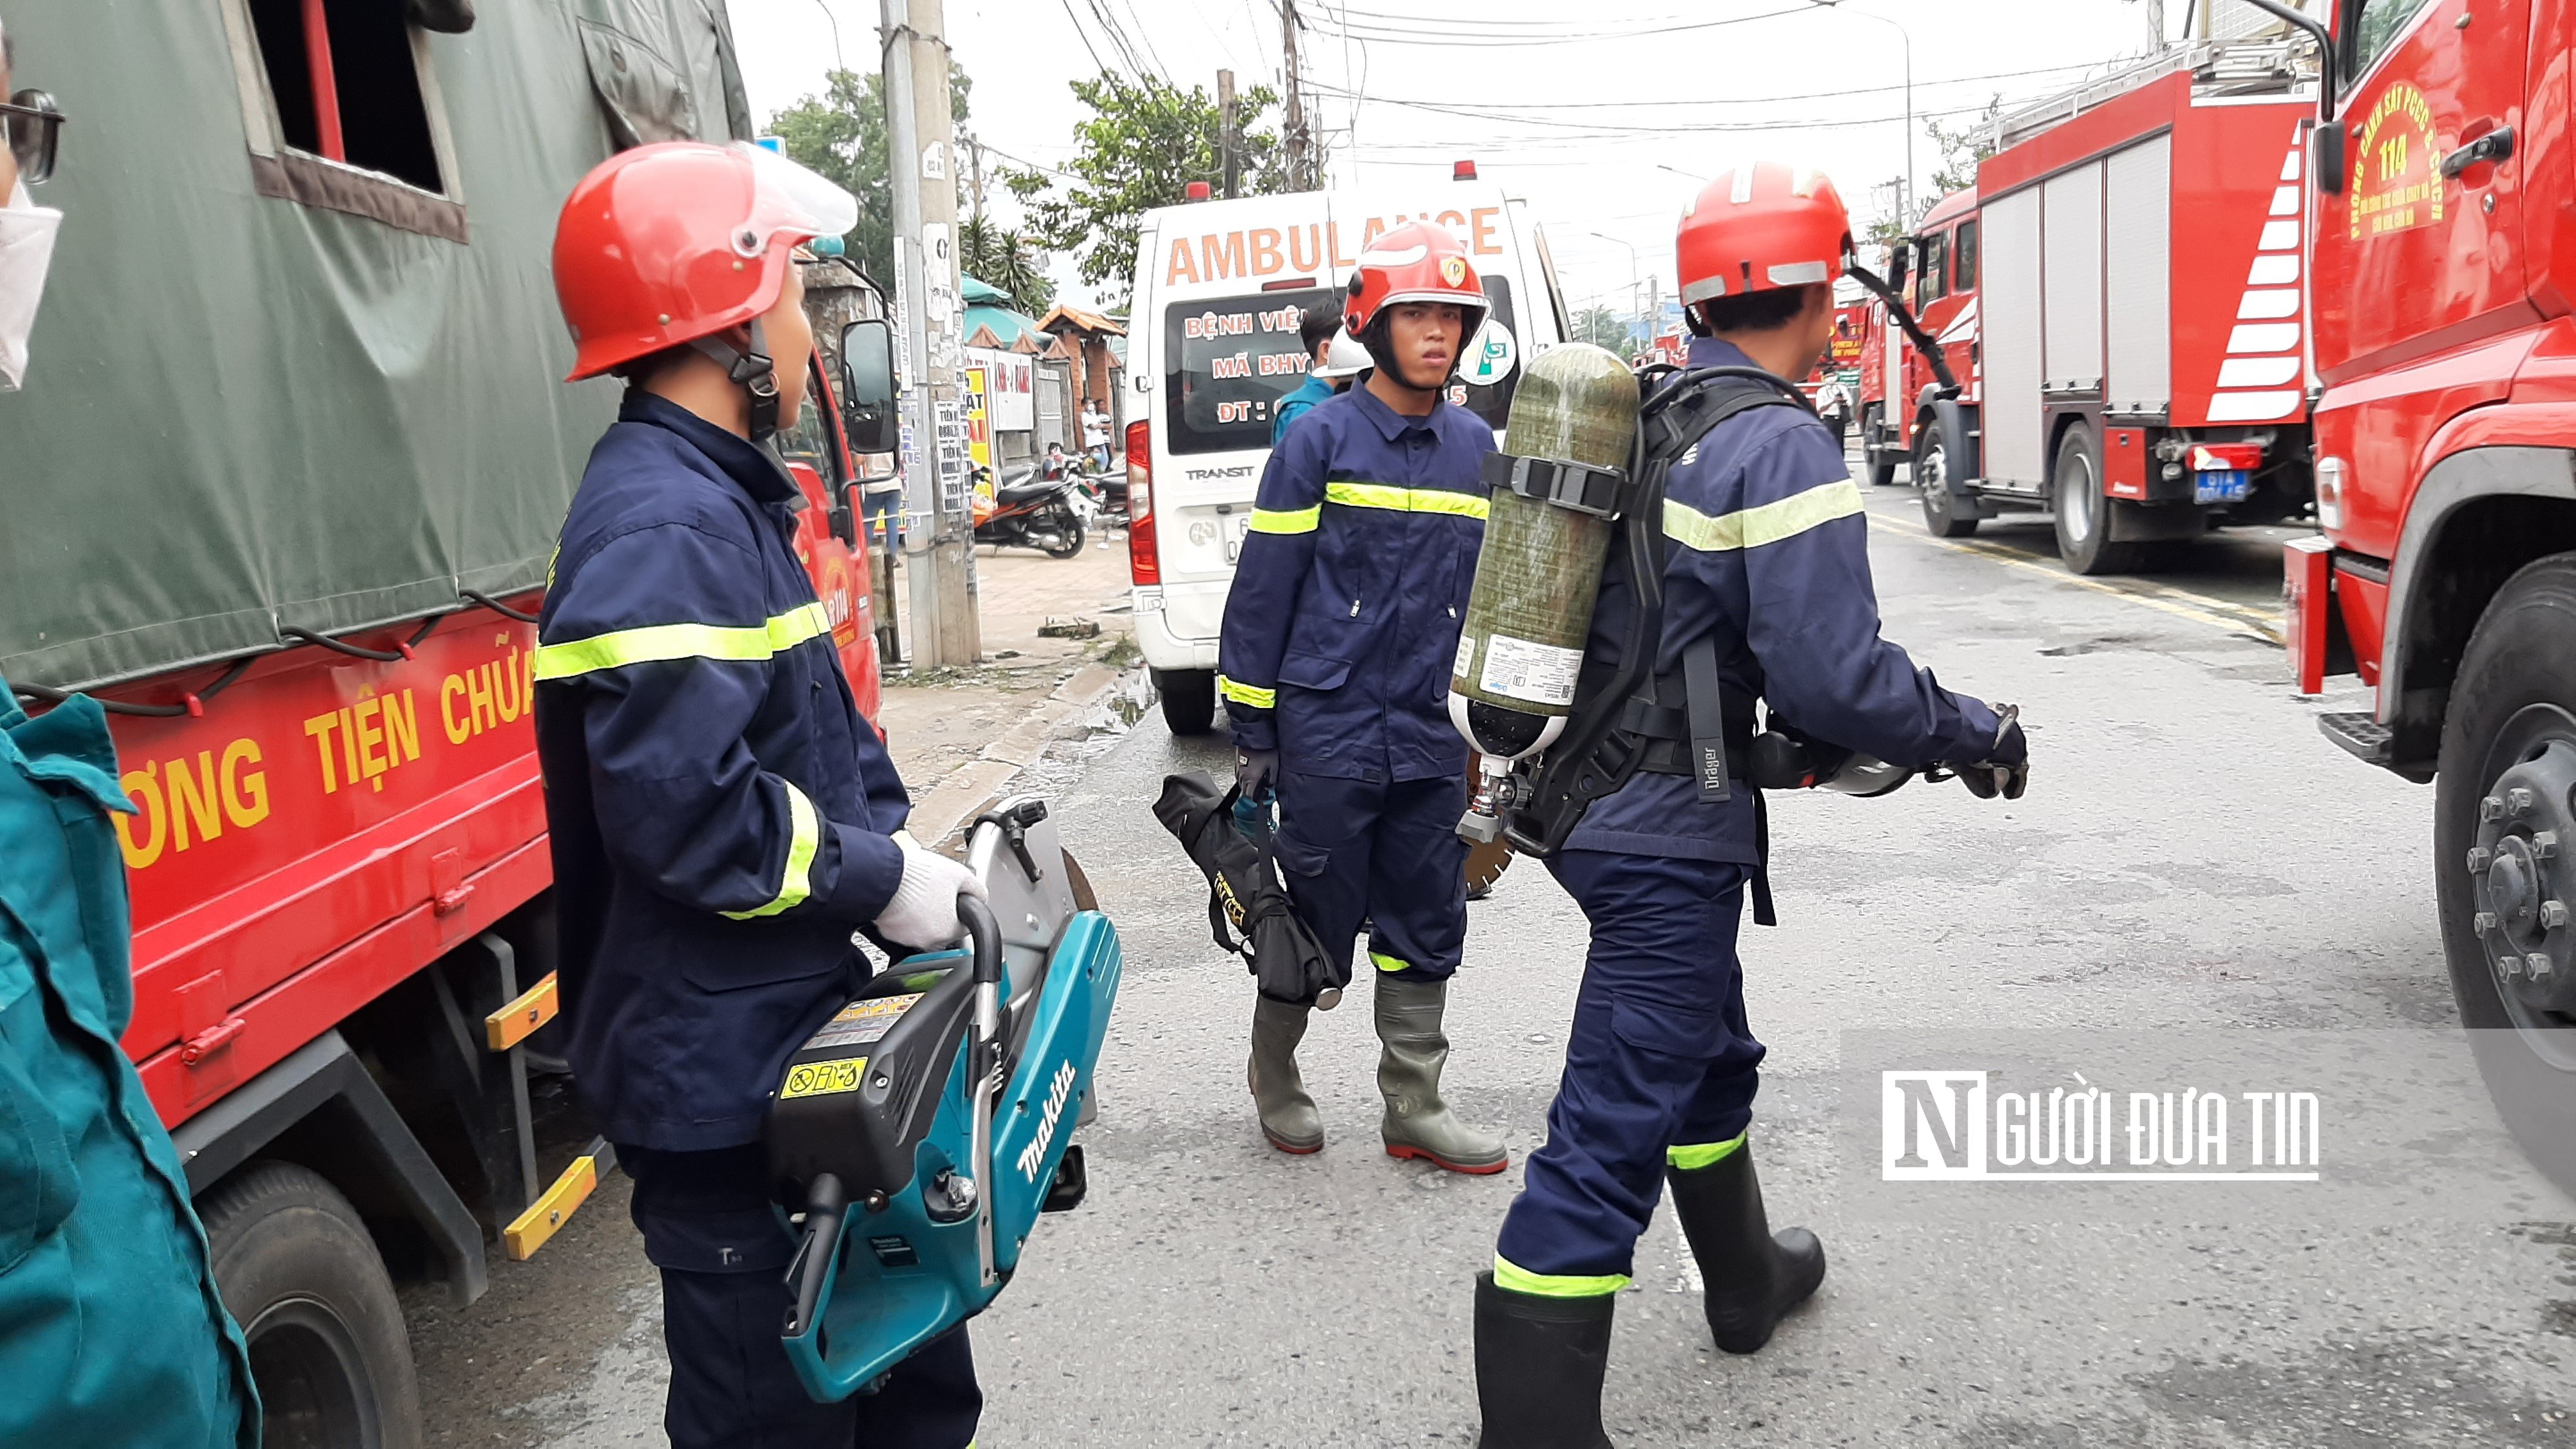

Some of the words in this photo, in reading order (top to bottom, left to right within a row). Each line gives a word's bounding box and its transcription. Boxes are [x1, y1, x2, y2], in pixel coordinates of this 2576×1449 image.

[2403, 86, 2430, 132] PCCC
[2379, 133, 2407, 182] 114
[1166, 206, 1503, 287] AMBULACE
[1184, 311, 1254, 341] BỆNH
[1258, 304, 1308, 335] VIỆ
[1212, 351, 1252, 379] MÃ
[1258, 352, 1314, 376] BHY
[1216, 401, 1252, 424] ĐT
[1185, 466, 1255, 480] TRANSIT
[303, 683, 421, 795] TIỆN
[1703, 746, 1720, 790] Dräger
